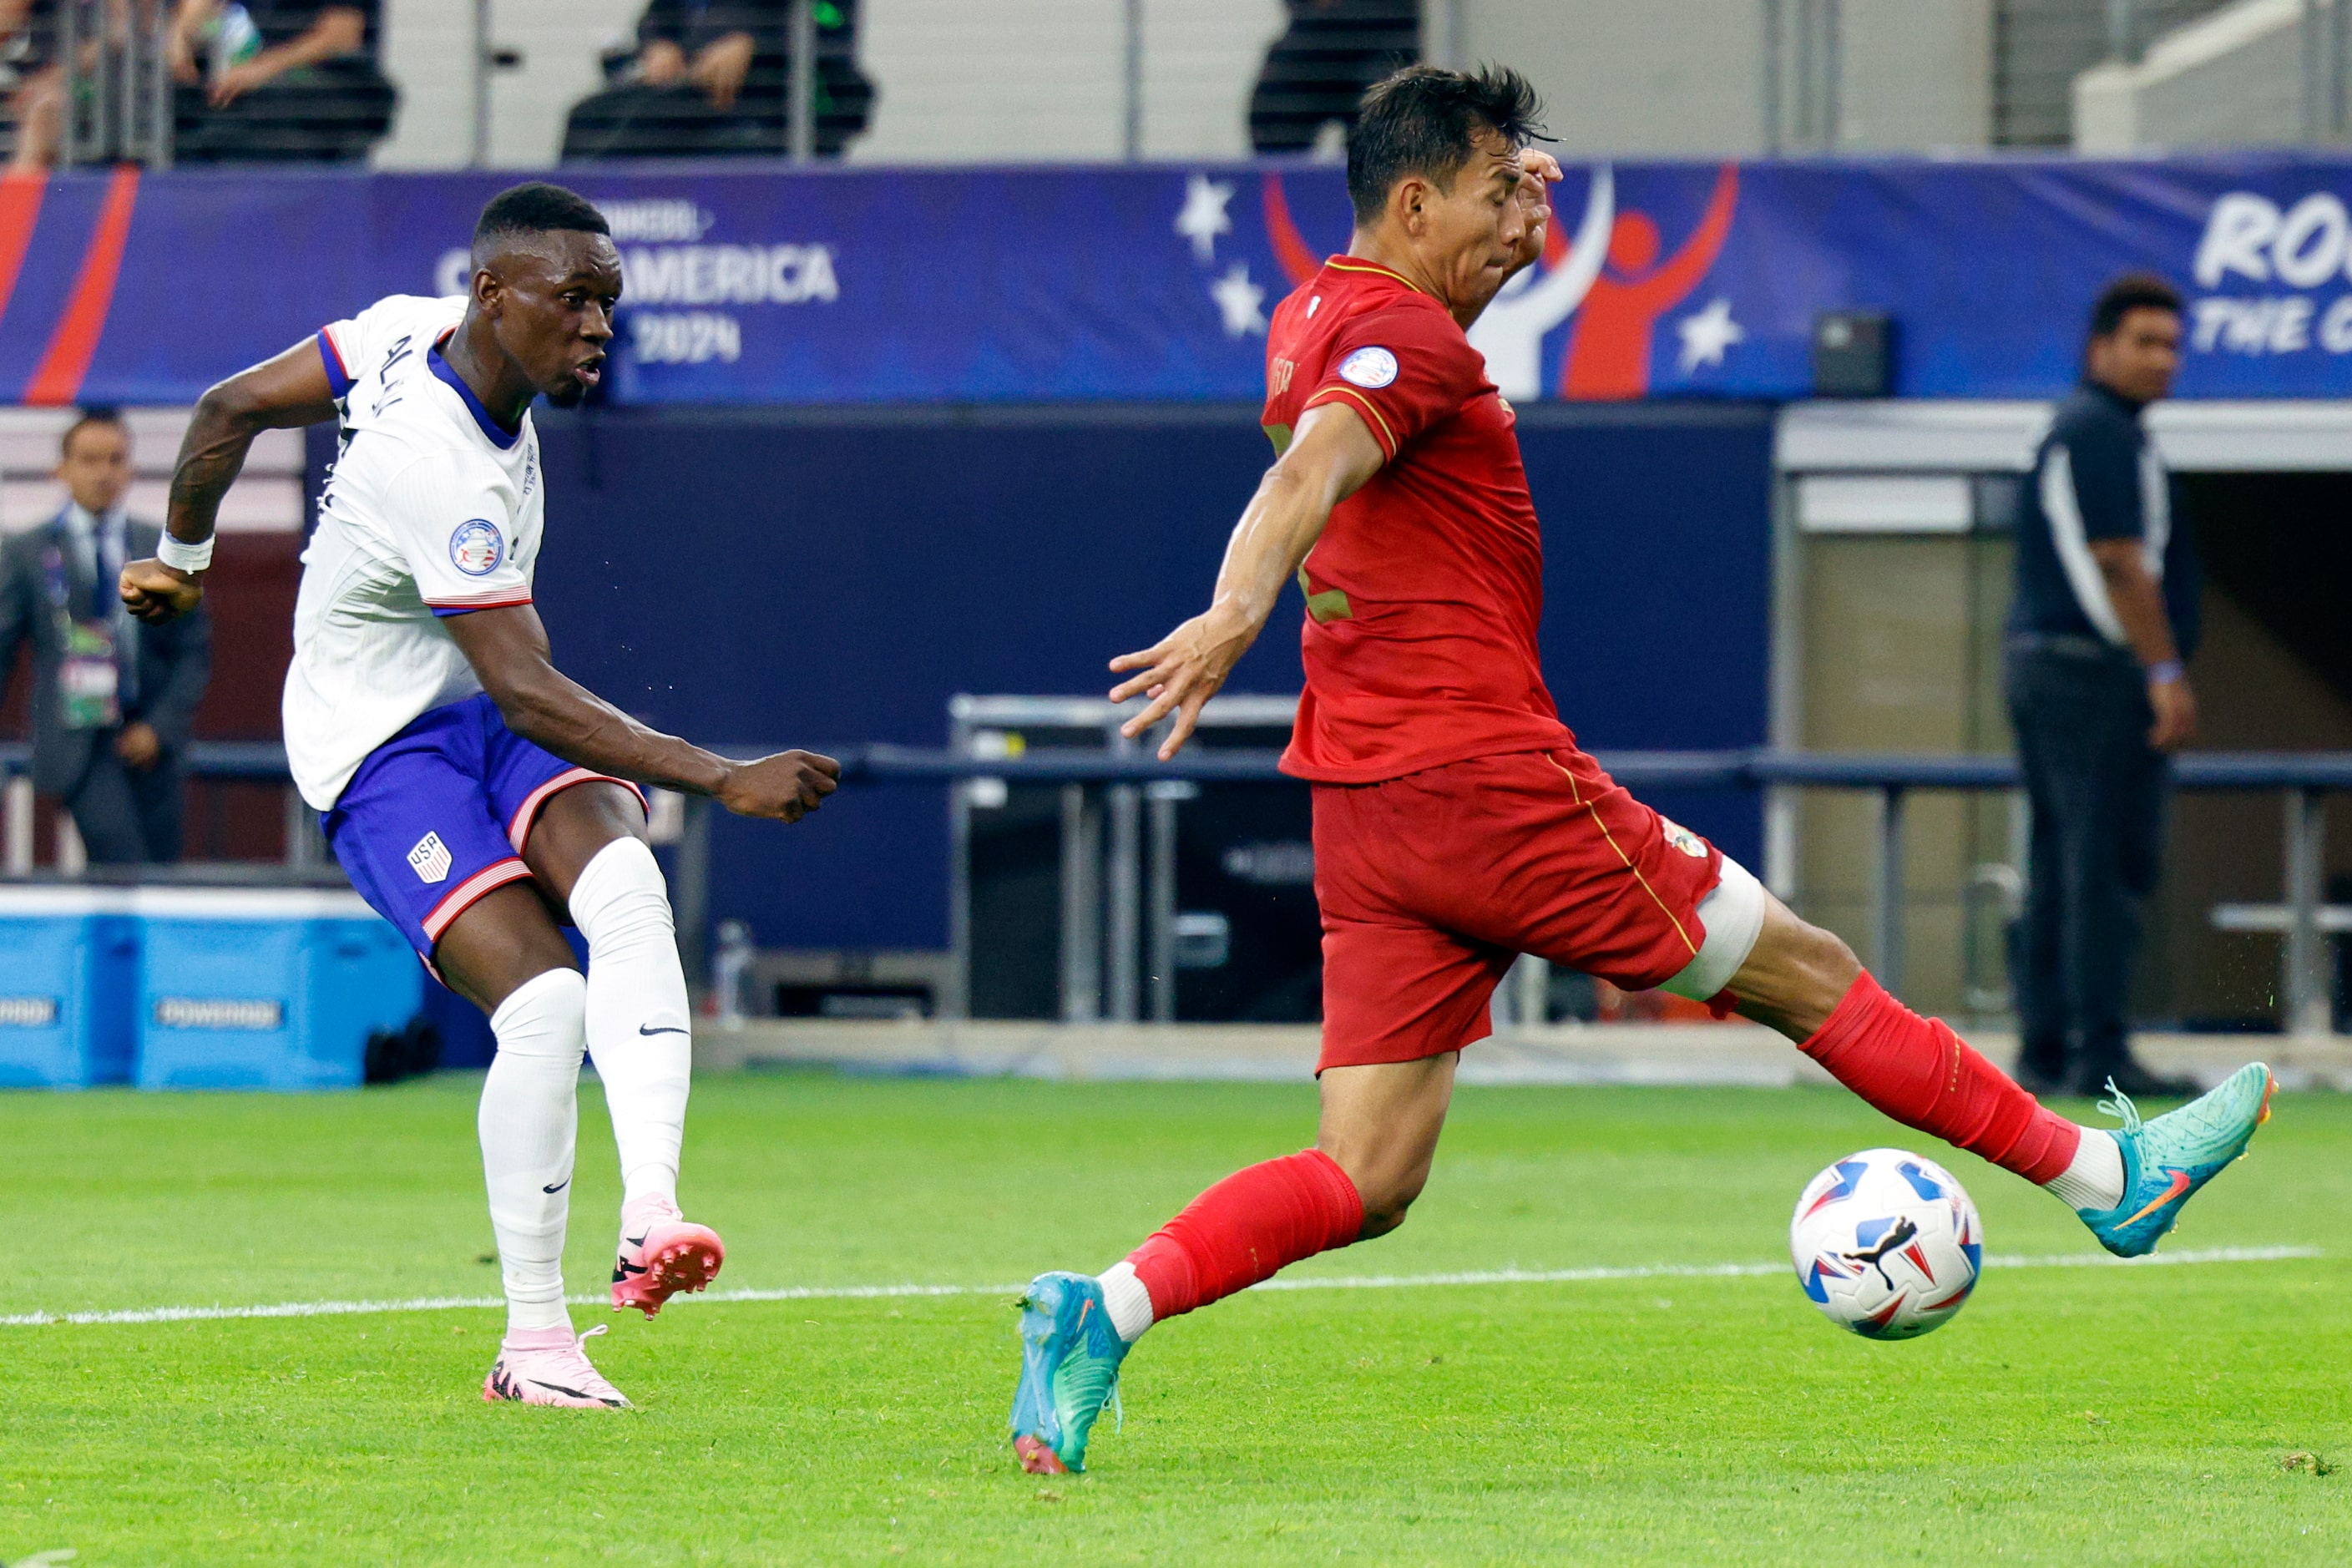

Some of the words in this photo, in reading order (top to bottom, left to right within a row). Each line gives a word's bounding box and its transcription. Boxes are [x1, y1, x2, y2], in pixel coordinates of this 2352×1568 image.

[2194, 190, 2352, 289] RO
[634, 312, 741, 364] 2024
[2192, 296, 2314, 356] THE
